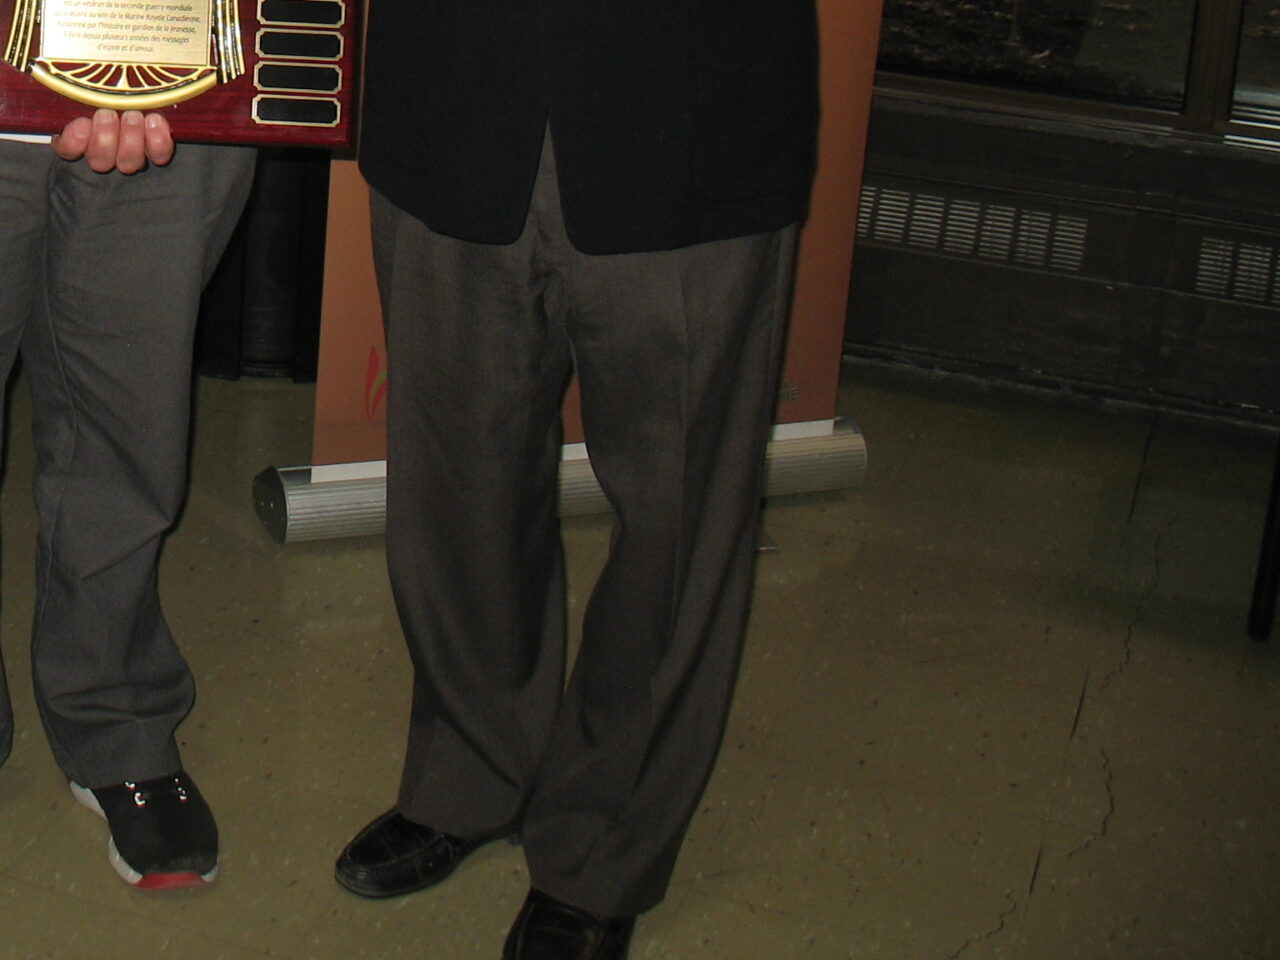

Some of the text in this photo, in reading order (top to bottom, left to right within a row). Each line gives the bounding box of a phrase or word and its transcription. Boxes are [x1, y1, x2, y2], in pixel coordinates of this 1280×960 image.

[165, 3, 193, 12] mondiale
[125, 11, 145, 20] Marine
[131, 23, 155, 33] gardien
[155, 24, 163, 32] de
[150, 34, 161, 43] des
